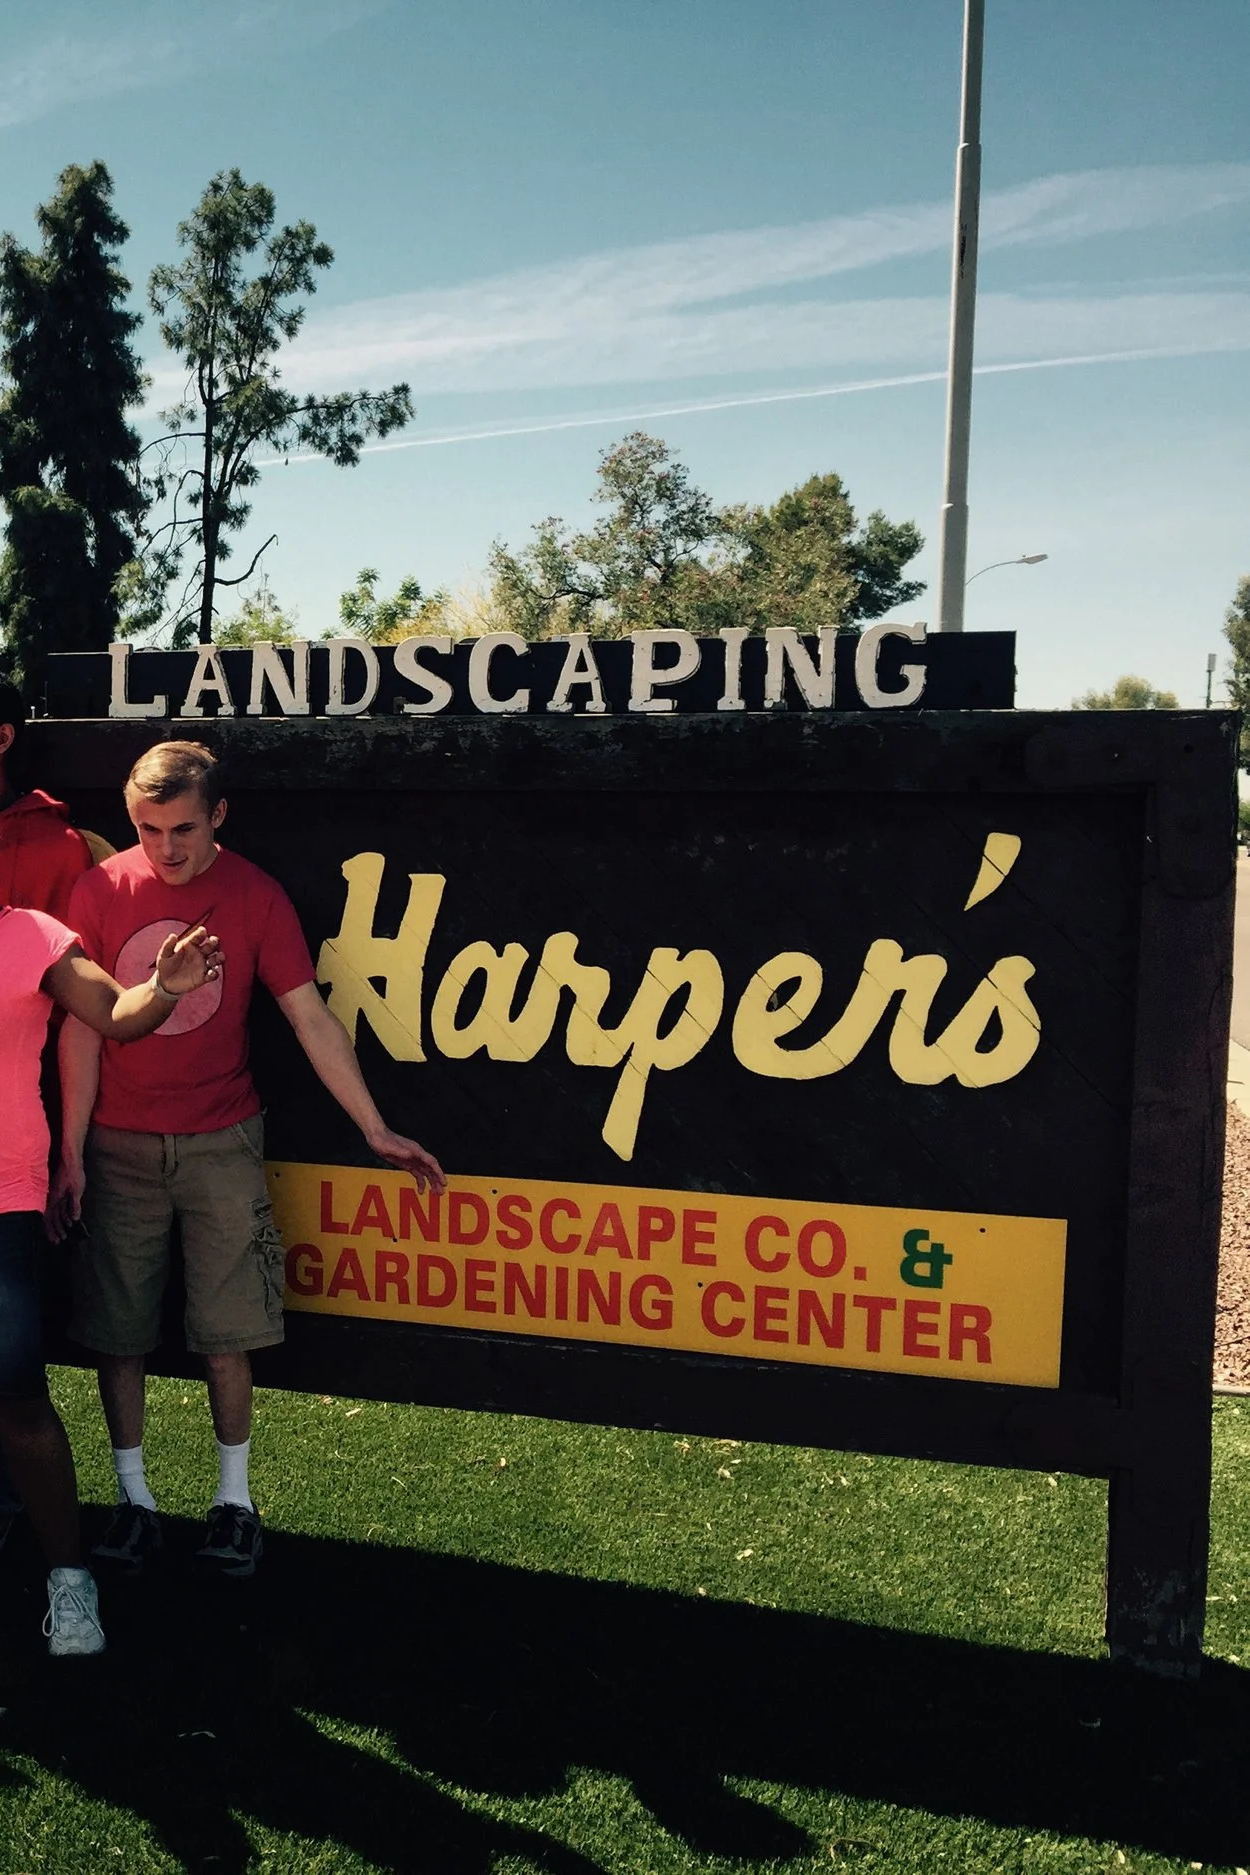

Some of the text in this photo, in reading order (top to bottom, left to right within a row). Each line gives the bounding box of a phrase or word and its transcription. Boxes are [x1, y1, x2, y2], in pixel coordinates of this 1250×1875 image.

[109, 622, 927, 718] LANDSCAPING
[316, 832, 1041, 1162] Harper's
[320, 1180, 953, 1289] LANDSCAPE CO. &
[284, 1243, 993, 1364] GARDENING CENTER
